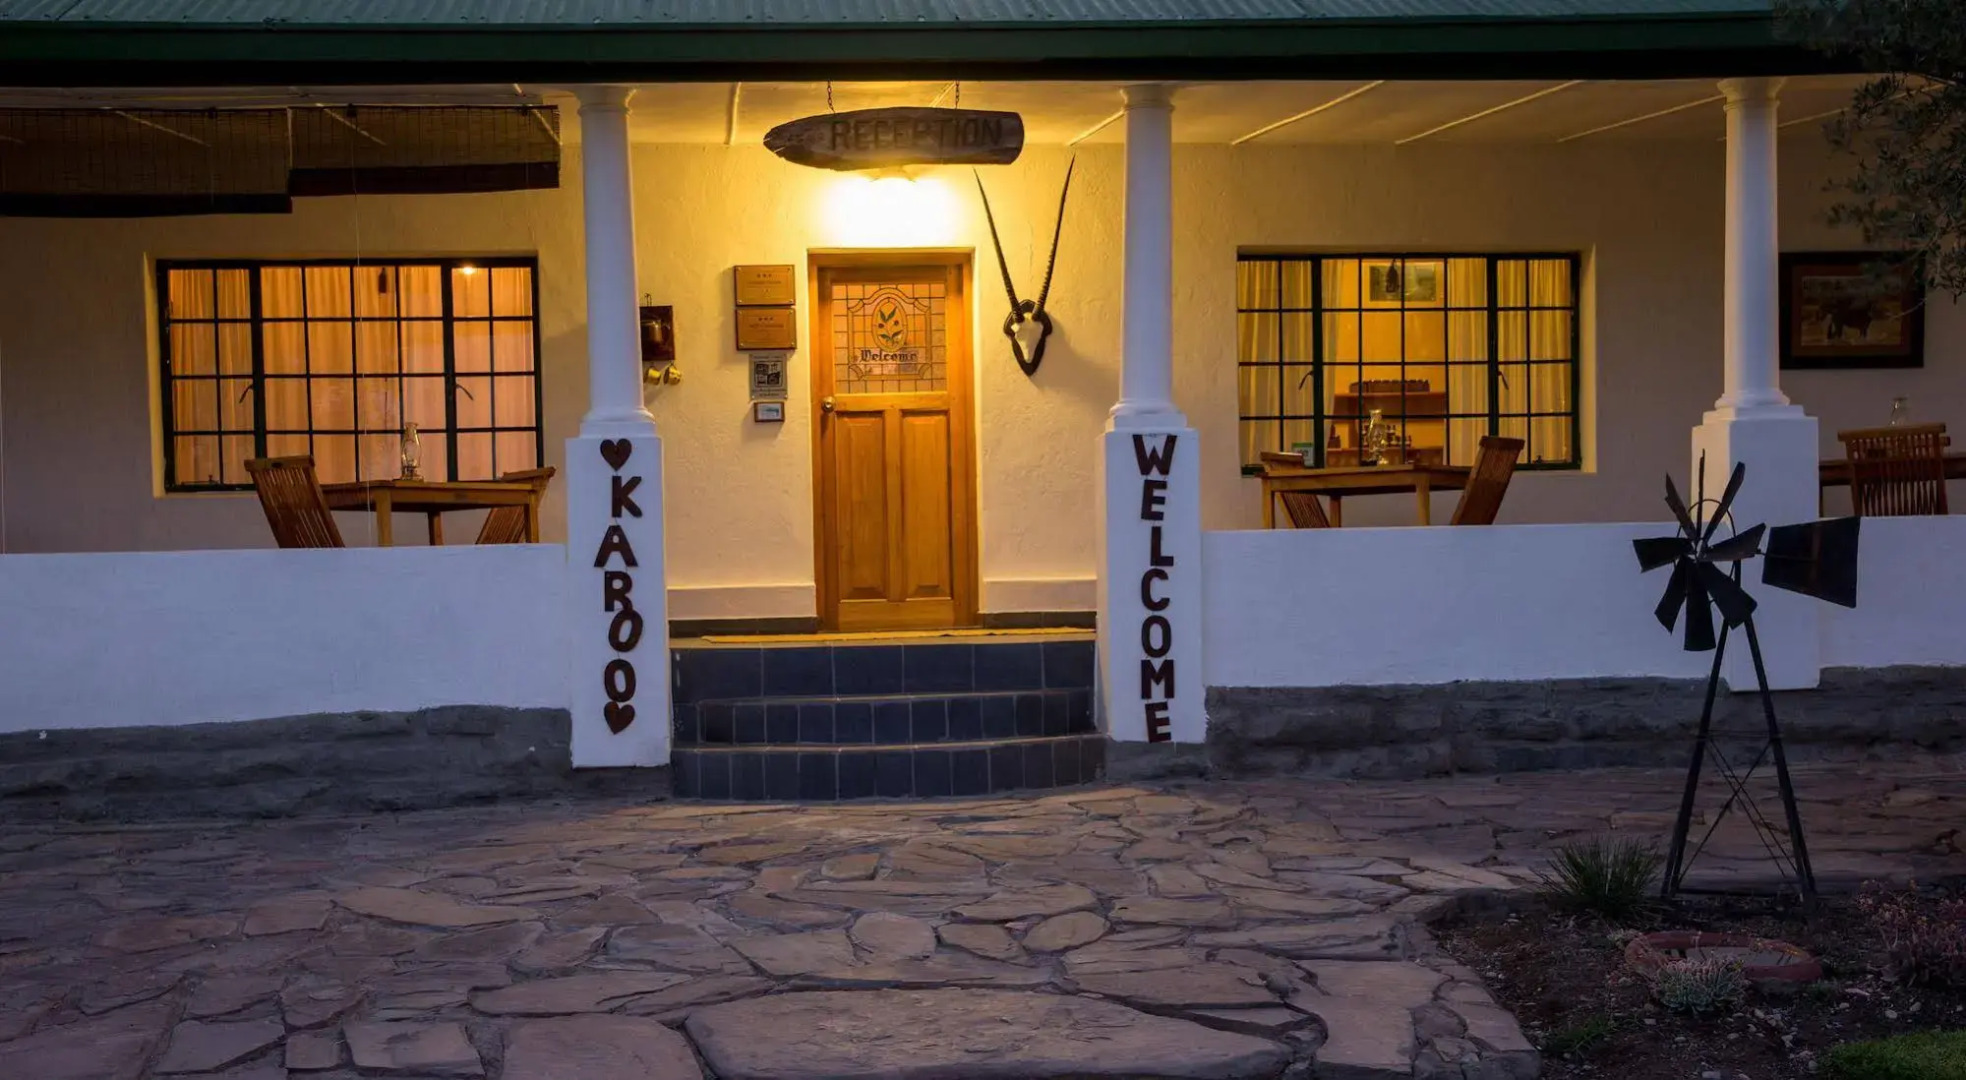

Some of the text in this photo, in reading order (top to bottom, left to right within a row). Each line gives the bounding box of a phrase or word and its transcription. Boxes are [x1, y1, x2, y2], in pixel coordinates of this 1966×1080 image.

[830, 117, 1003, 150] RECEPTION
[860, 349, 917, 361] Welcome
[594, 475, 643, 702] KAROO
[1132, 434, 1177, 743] WELCOME
